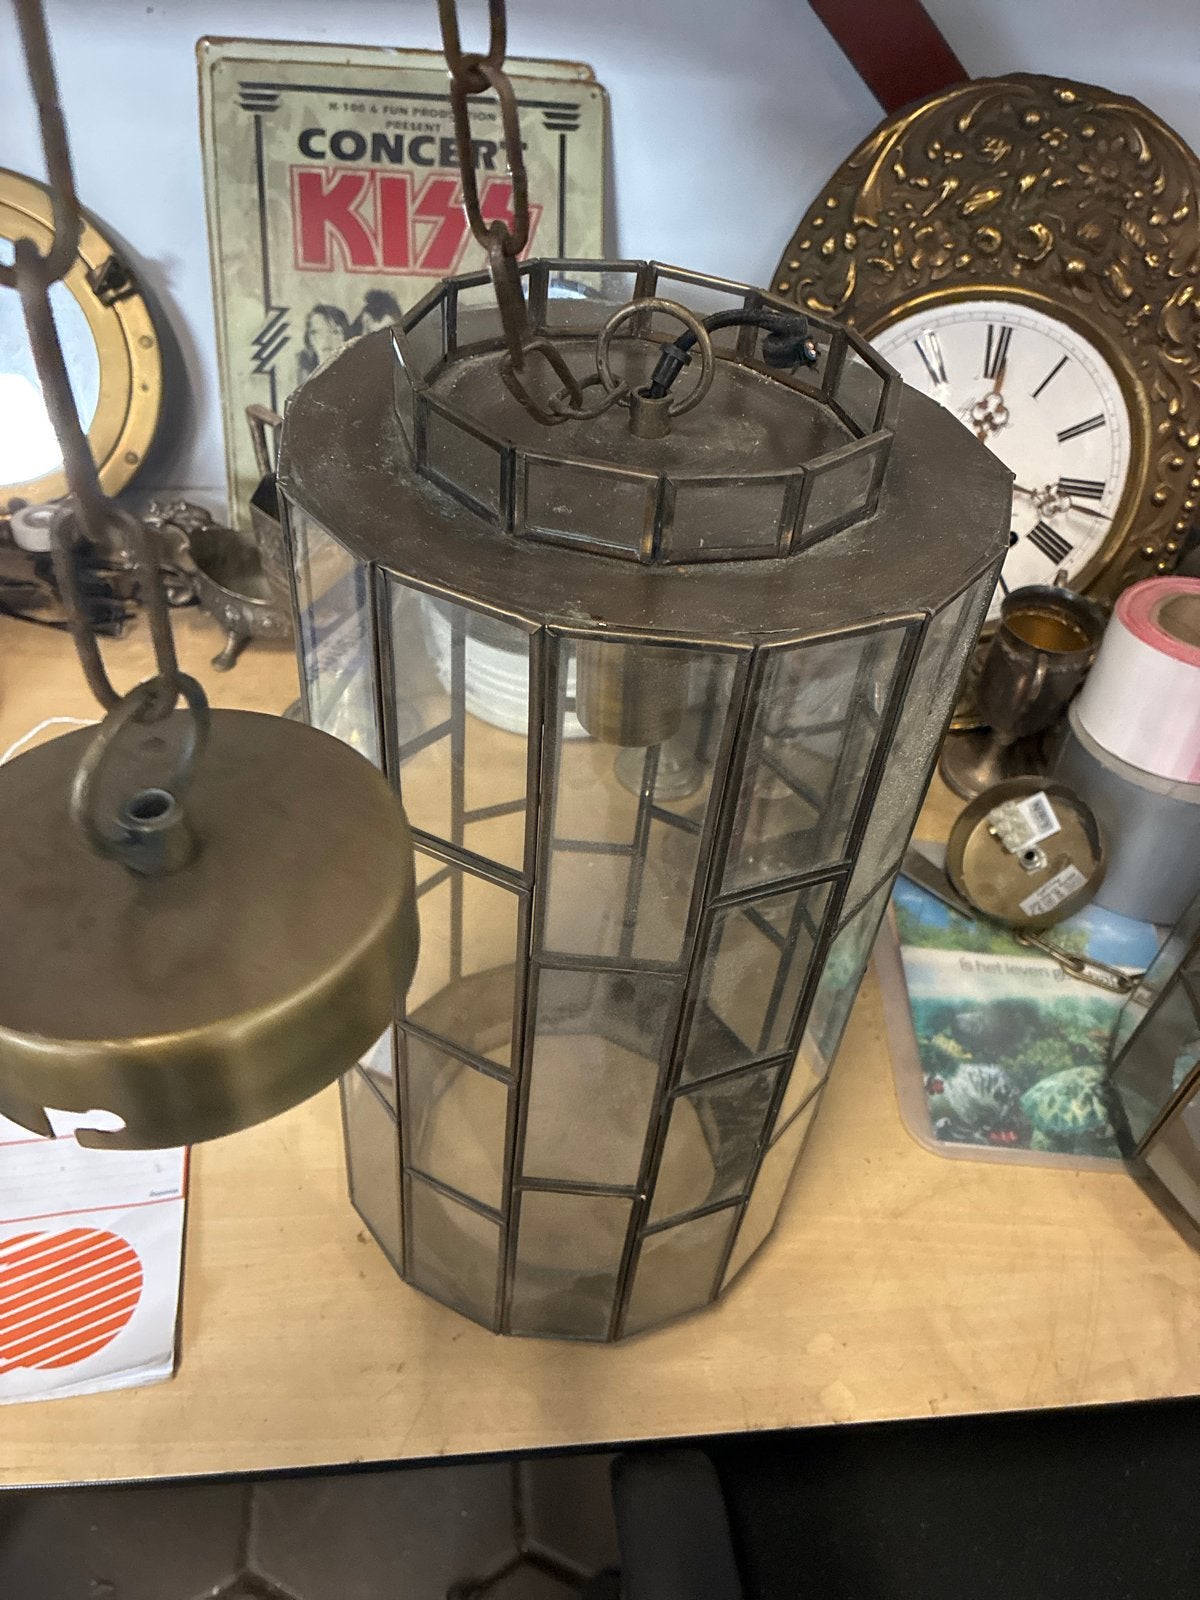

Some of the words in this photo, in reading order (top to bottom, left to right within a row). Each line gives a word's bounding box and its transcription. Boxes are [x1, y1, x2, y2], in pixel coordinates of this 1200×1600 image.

[383, 104, 408, 116] FUN
[411, 106, 497, 122] PRODION
[385, 119, 441, 133] PRESENT
[289, 163, 544, 278] KISS
